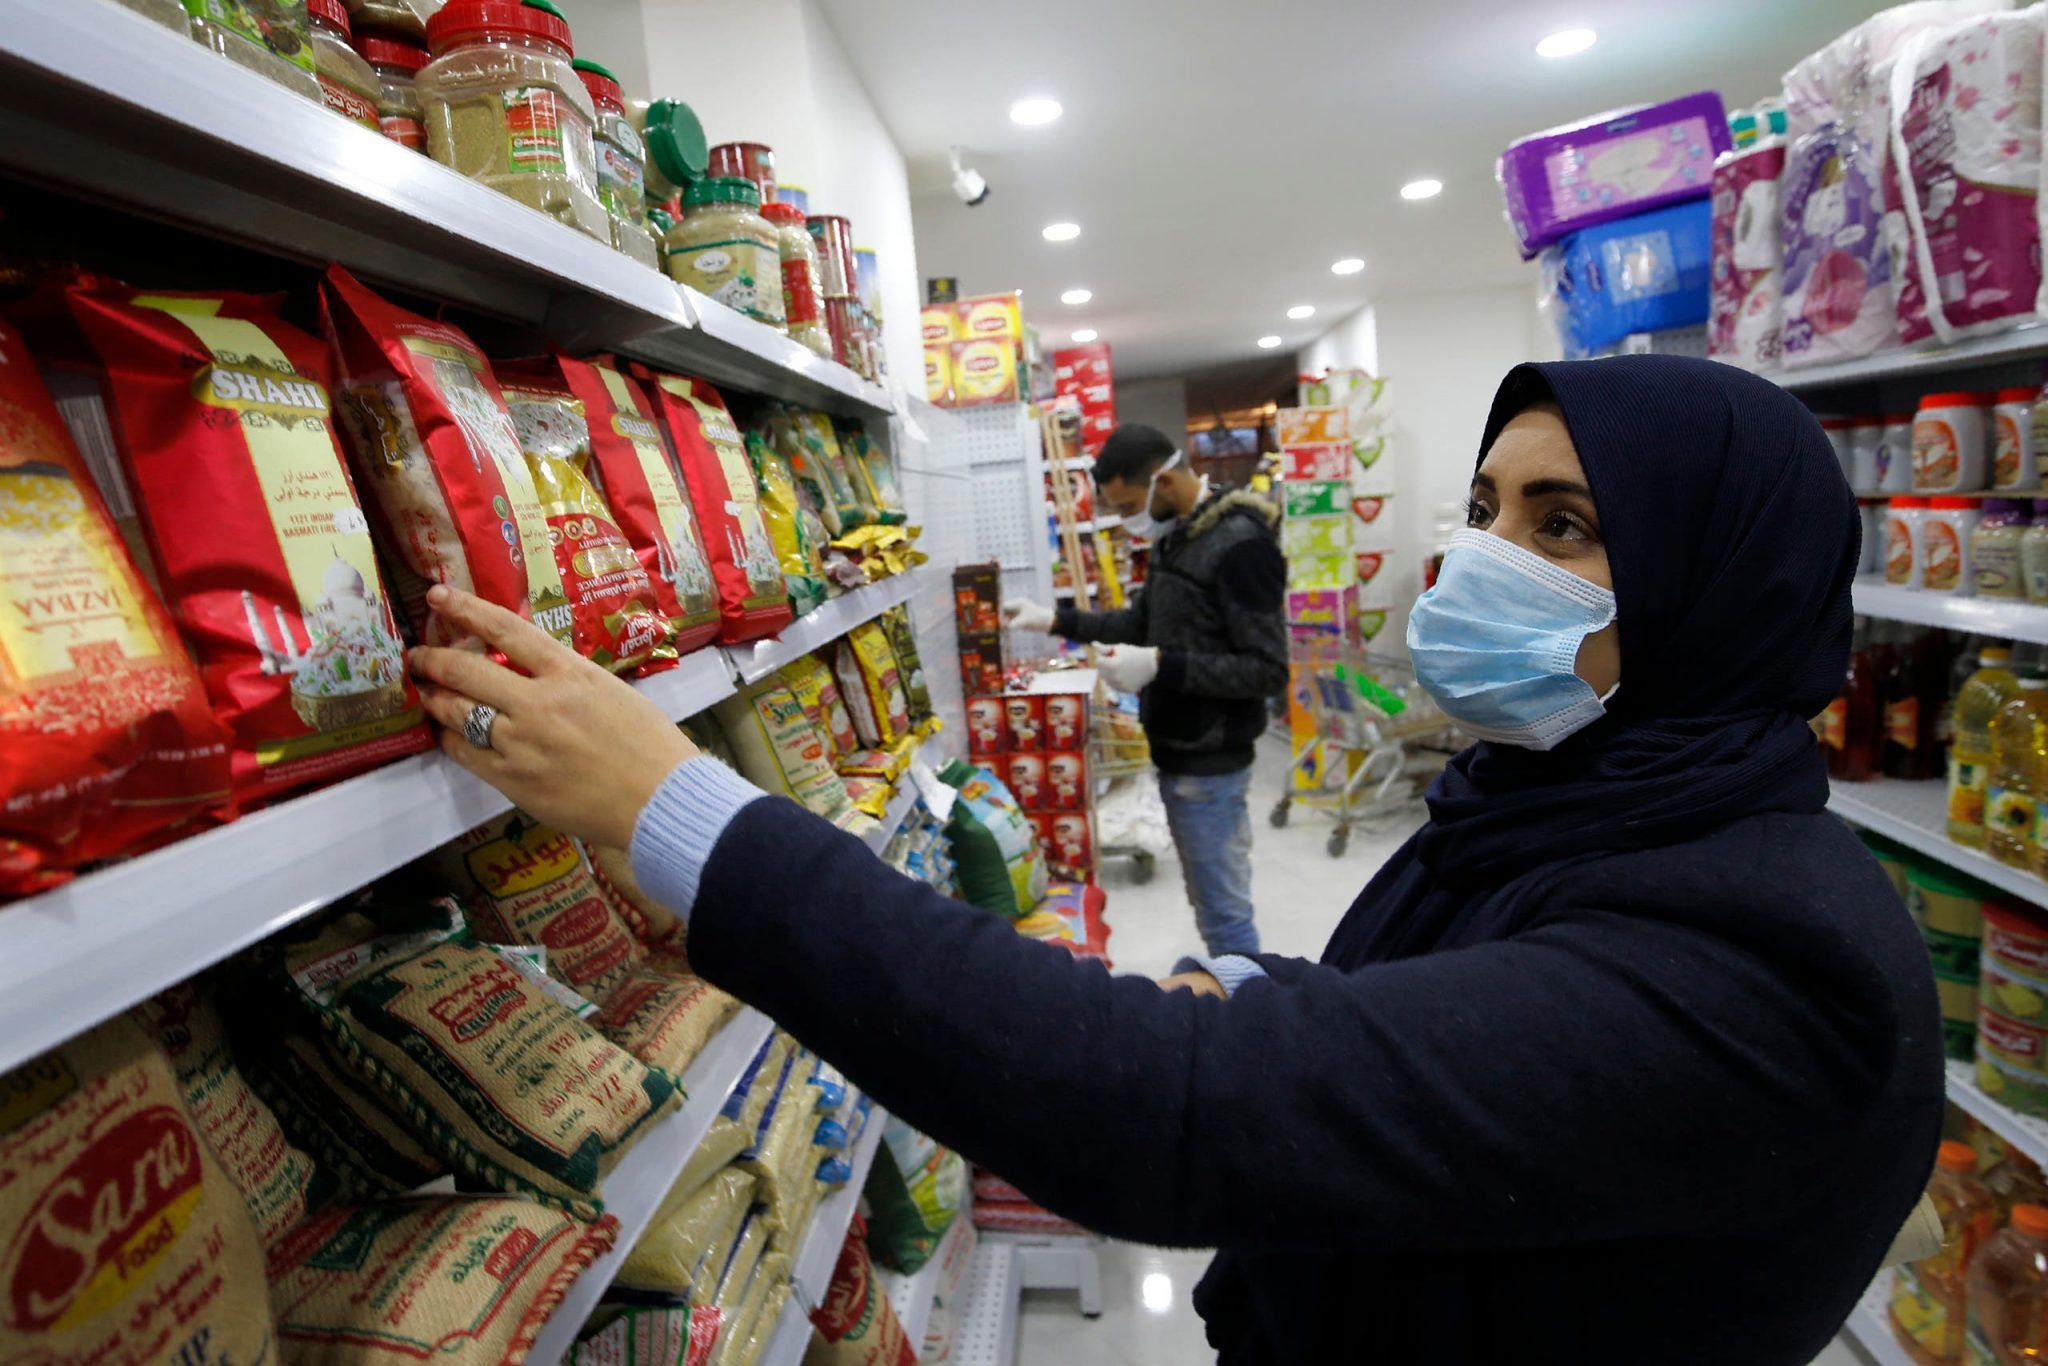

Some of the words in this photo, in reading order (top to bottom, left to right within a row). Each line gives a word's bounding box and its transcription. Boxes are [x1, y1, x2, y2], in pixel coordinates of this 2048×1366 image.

[210, 368, 328, 410] SHAHI
[622, 417, 656, 440] SHAHI
[706, 422, 739, 441] SHAHI
[28, 1128, 187, 1318] Sara
